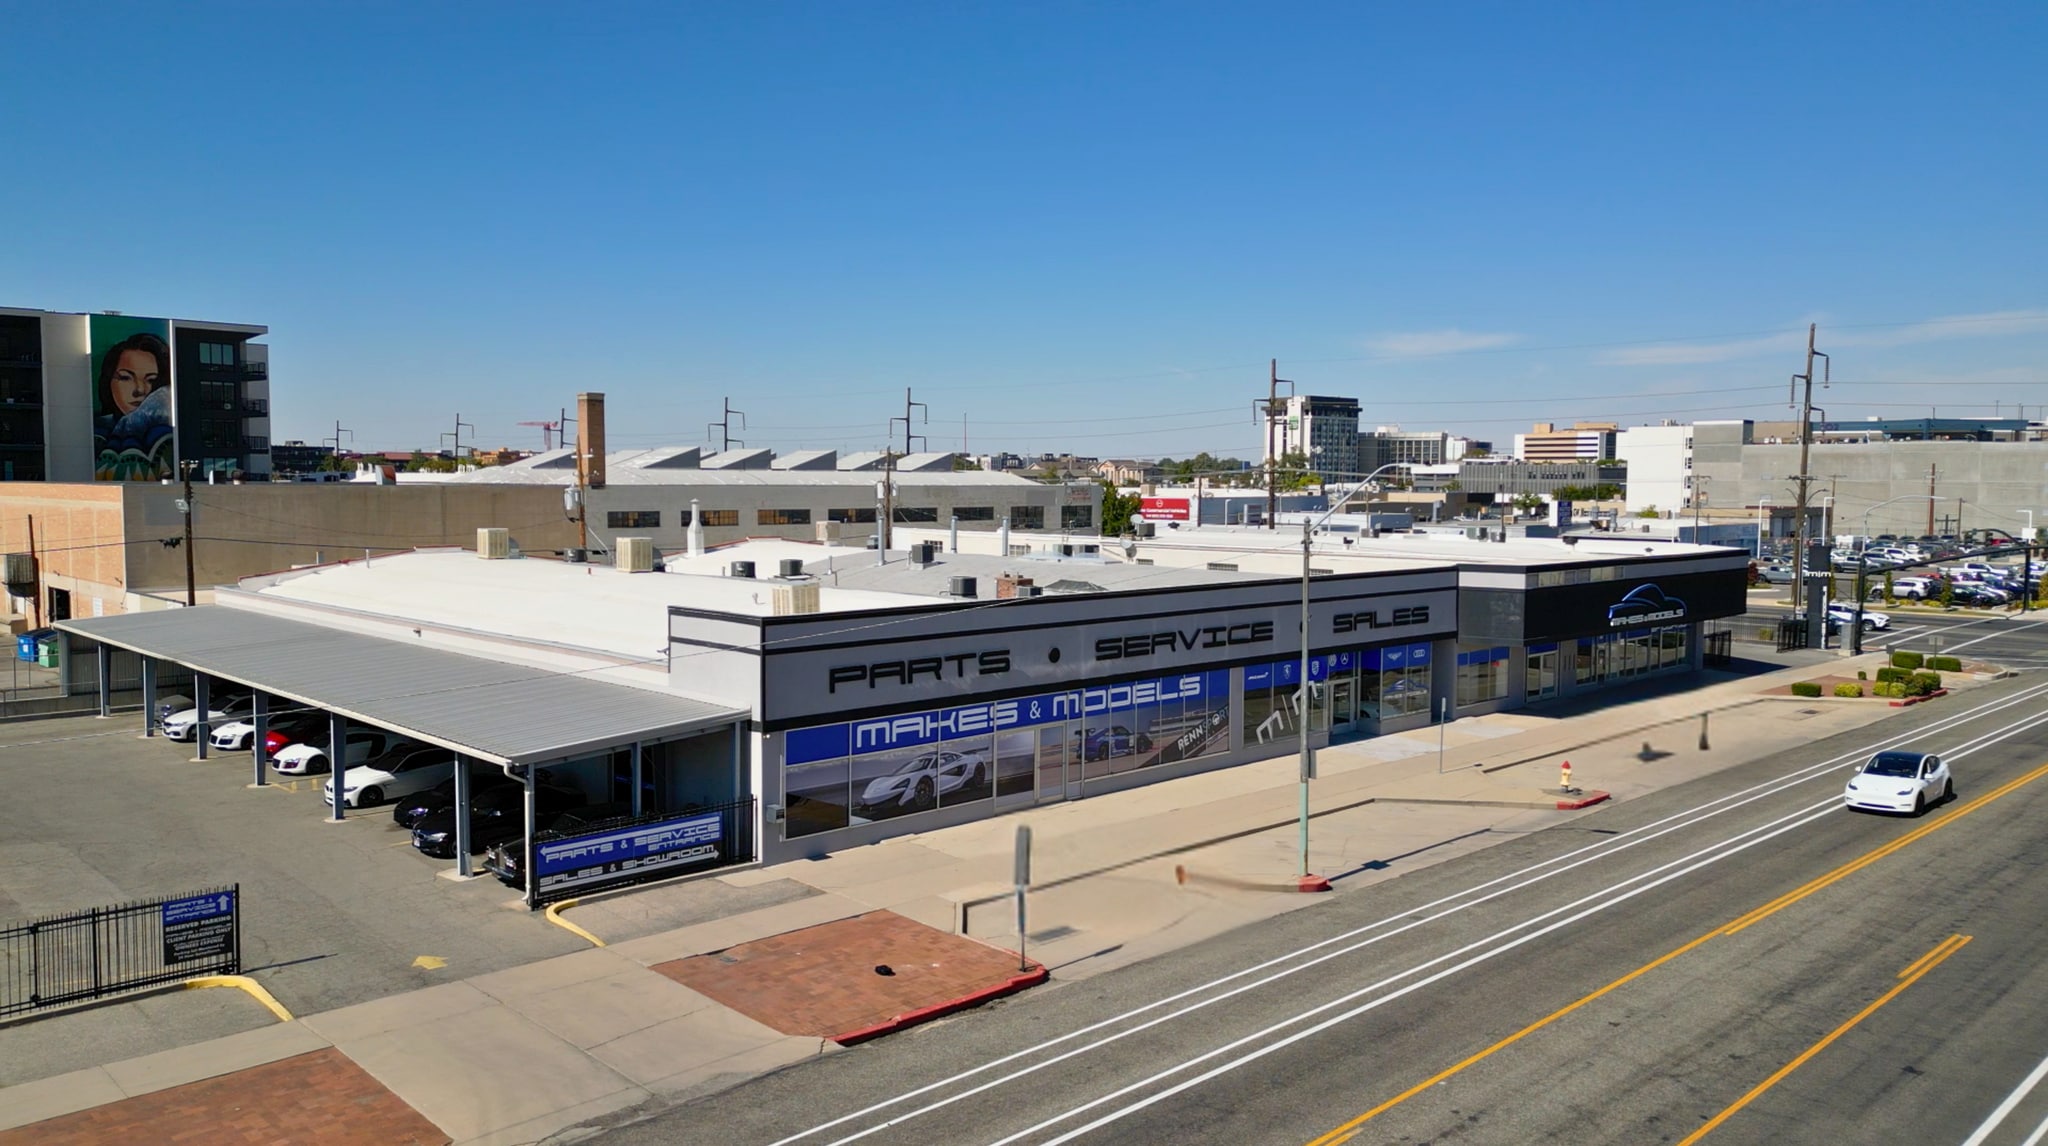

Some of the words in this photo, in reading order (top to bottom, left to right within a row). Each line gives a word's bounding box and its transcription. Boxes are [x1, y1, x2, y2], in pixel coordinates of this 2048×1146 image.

[1648, 608, 1684, 621] MODELS
[829, 649, 1010, 694] PARTS
[1096, 621, 1273, 661] SERVICE
[1333, 606, 1429, 633] SALES
[857, 702, 1018, 748] MAKES
[1030, 701, 1041, 719] &
[1053, 676, 1200, 717] MODELS
[546, 842, 613, 863] PARTS
[620, 840, 628, 849] &
[634, 823, 720, 846] SERVICE
[648, 832, 720, 851] ENTRANCE
[540, 866, 603, 886] SALES
[609, 864, 617, 872] &
[622, 844, 714, 870] SHOWROOM
[165, 921, 199, 932] RESERVED
[200, 915, 231, 925] PARKING
[166, 936, 187, 944] CLIENT
[188, 931, 214, 940] PARKING
[215, 926, 232, 934] ONLY
